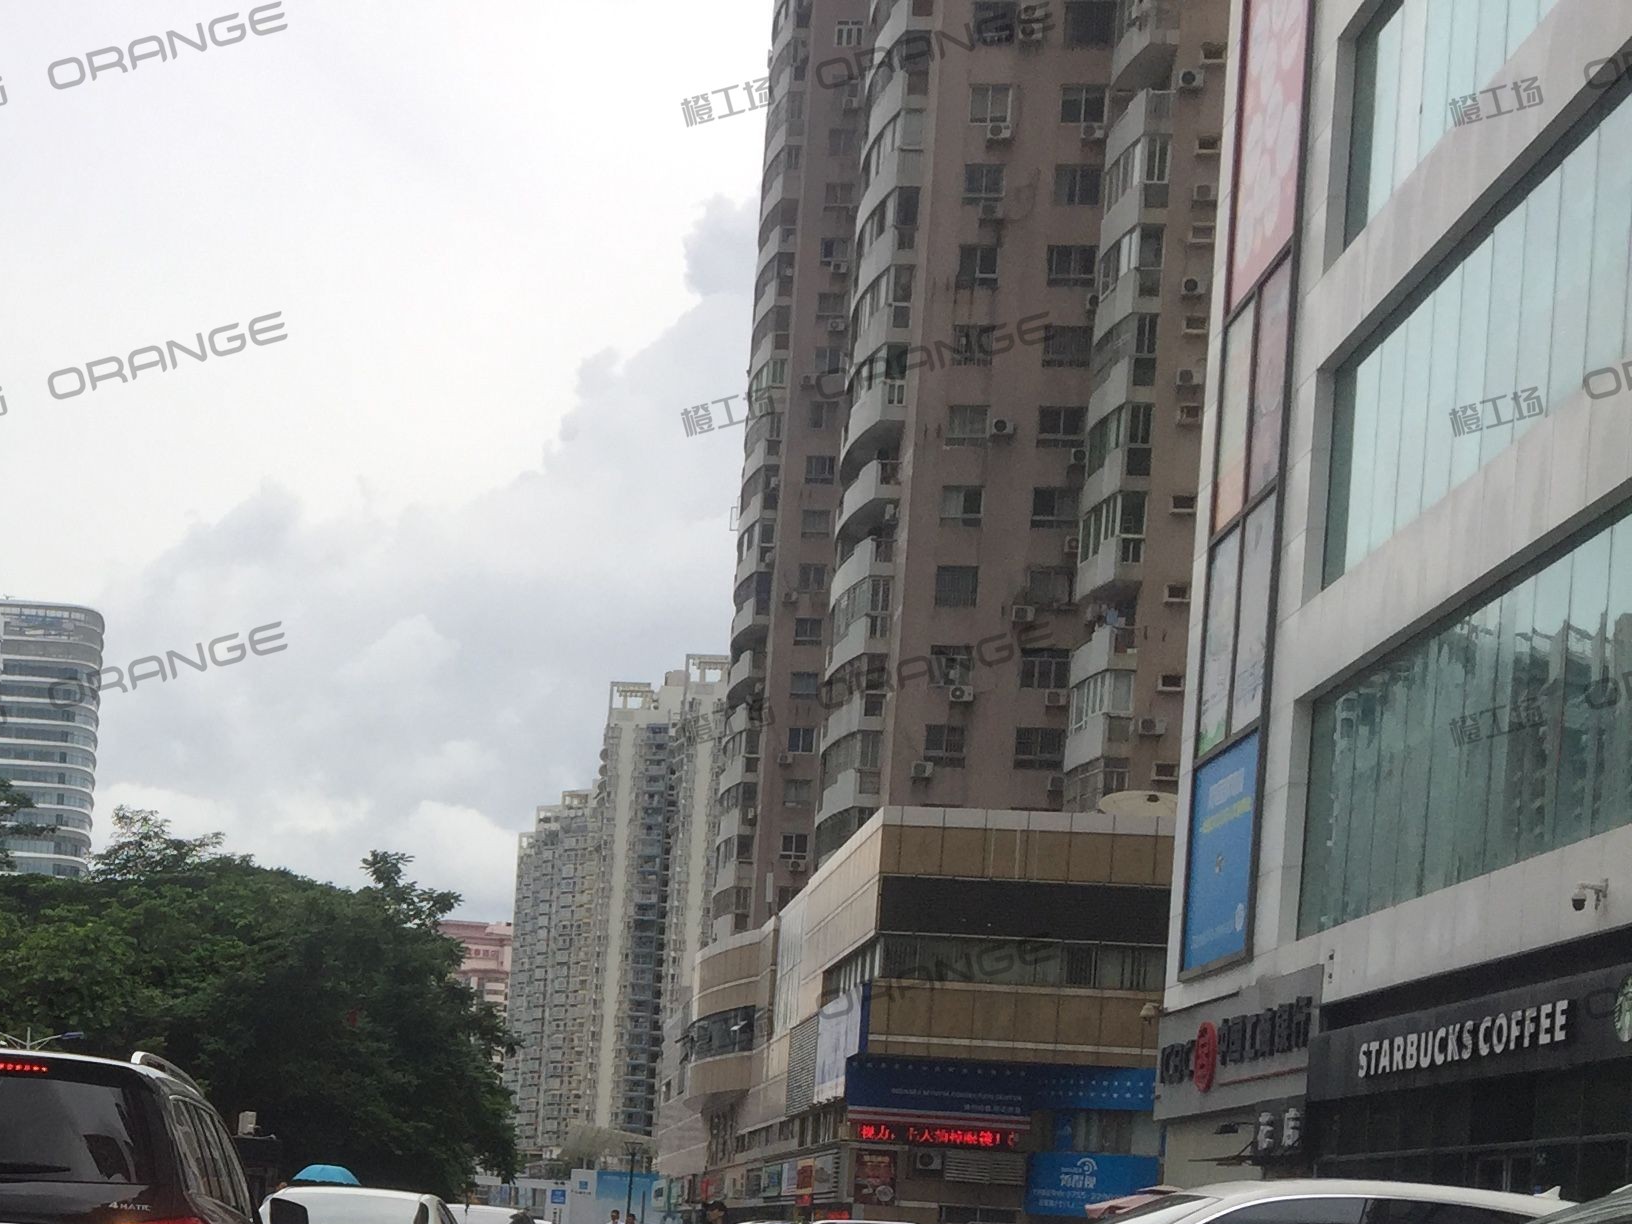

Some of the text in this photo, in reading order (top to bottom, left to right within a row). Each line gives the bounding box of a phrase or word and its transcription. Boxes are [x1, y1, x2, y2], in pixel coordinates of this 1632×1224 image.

[1218, 995, 1313, 1067] 中国工商银行
[1358, 999, 1569, 1079] STARBUCKS COFFEE
